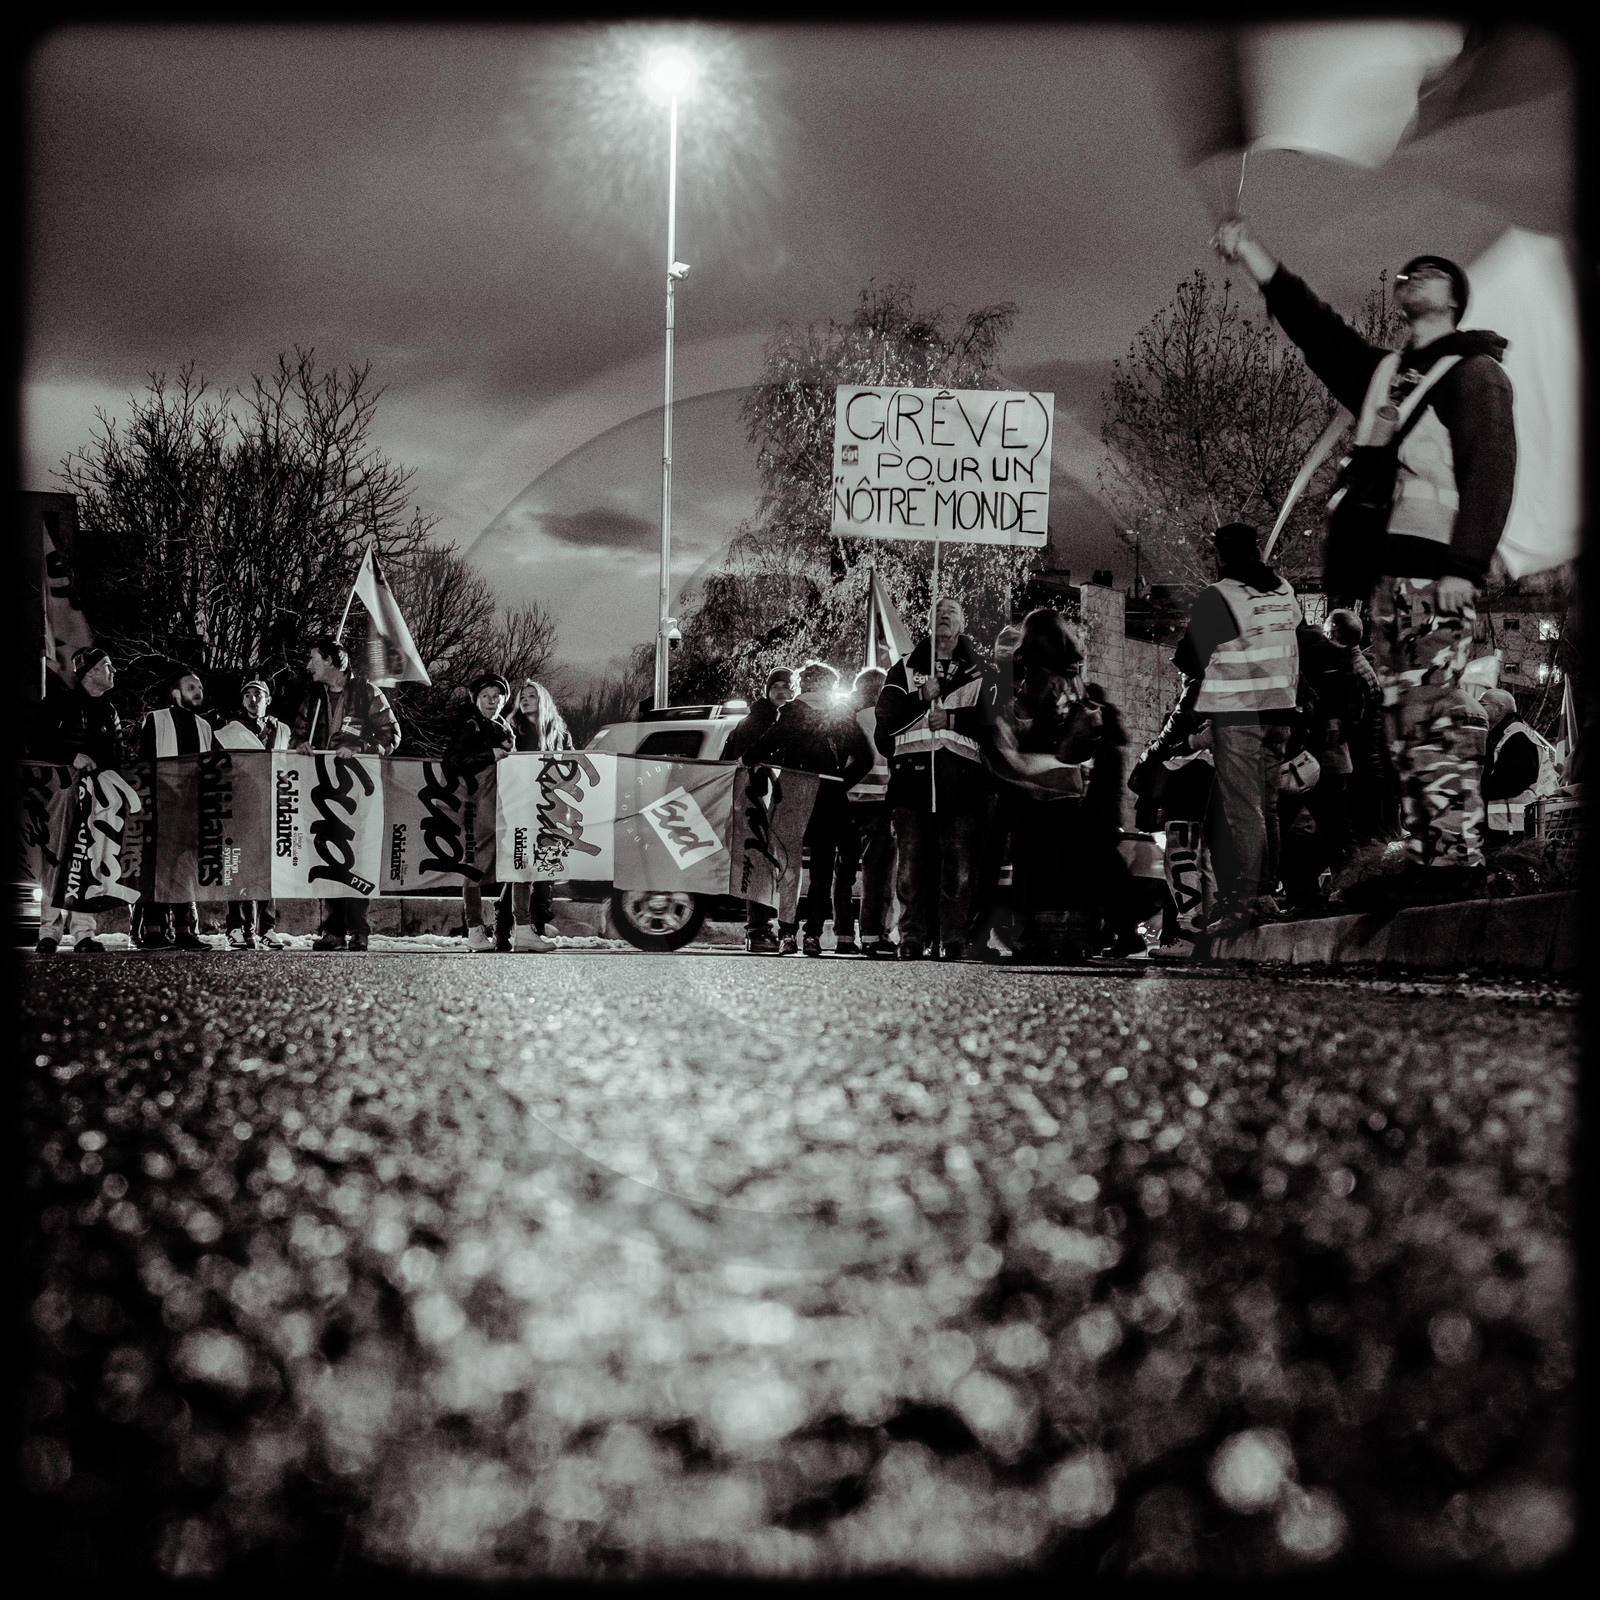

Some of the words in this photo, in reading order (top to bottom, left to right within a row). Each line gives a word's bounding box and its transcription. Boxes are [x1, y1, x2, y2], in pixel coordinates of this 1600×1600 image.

[845, 389, 1049, 458] G(RÊVE)
[877, 452, 983, 483] POUR
[992, 456, 1034, 483] UN
[934, 489, 1049, 535] MONDE
[85, 769, 142, 904] Sud
[198, 751, 233, 887] Solidaires
[276, 769, 300, 858] Solidaires
[307, 753, 376, 896] Sud
[417, 760, 485, 883] Sud
[622, 792, 650, 851] soiaux
[222, 847, 234, 886] syndicale
[231, 847, 242, 875] Union
[391, 823, 407, 881] Solidaires
[514, 827, 528, 870] Solidaires
[1168, 822, 1202, 914] FILA
[350, 876, 372, 893] PTT
